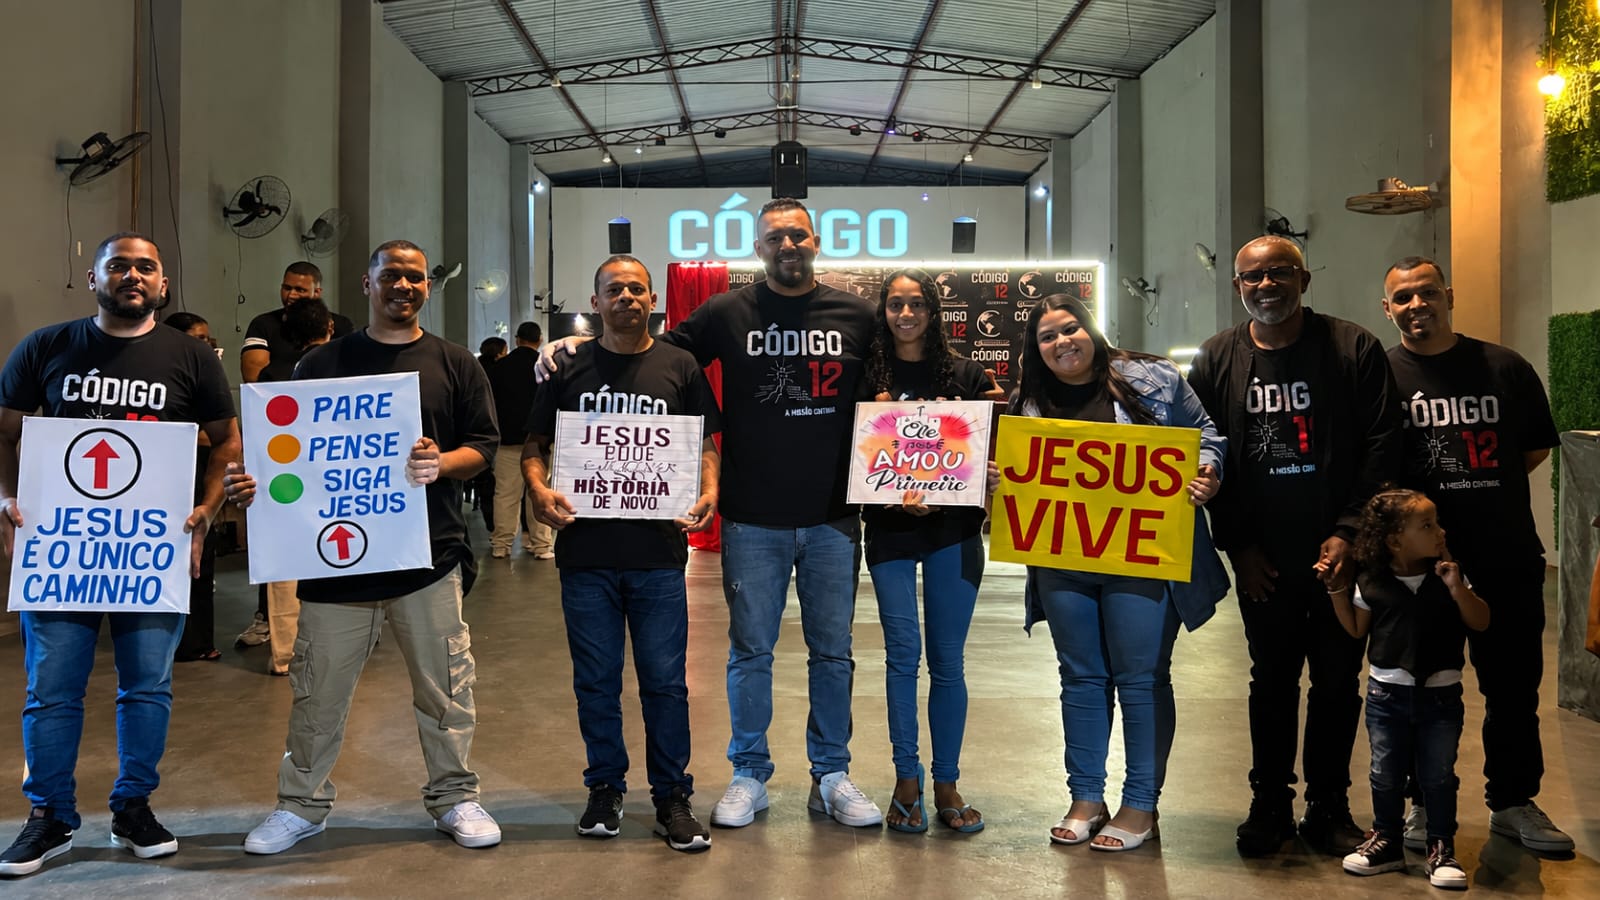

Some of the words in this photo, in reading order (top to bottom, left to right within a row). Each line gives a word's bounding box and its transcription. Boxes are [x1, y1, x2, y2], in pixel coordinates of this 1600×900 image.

[668, 192, 908, 258] CÓGO
[971, 269, 1009, 284] CÓDIGO
[1055, 268, 1093, 283] CÓDIGO
[1078, 283, 1092, 298] 12
[994, 284, 1009, 299] 12
[942, 311, 967, 322] DIGO
[952, 323, 967, 337] 12
[746, 322, 842, 357] CÓDIGO
[971, 347, 1009, 361] CÓDIGO
[808, 361, 843, 399] 12
[996, 362, 1009, 376] 12
[62, 368, 167, 410] CÓDIGO
[579, 384, 668, 415] CÓDIGO
[1246, 376, 1311, 413] ÓDIG
[313, 392, 393, 423] PARE
[308, 432, 400, 462] PENSE
[581, 425, 671, 447] JESUS
[1293, 415, 1314, 454] 1
[1462, 430, 1498, 469] 12
[873, 448, 965, 472] AMOU
[1004, 436, 1185, 497] JESUS
[323, 465, 391, 493] SIGA
[318, 491, 406, 518] JESUS
[592, 495, 611, 509] DE
[36, 507, 167, 537] JESUS
[1003, 494, 1165, 565] VIVE
[21, 536, 38, 569] É
[47, 540, 69, 569] O
[78, 533, 174, 570] ÚNICO
[22, 574, 162, 604] CAMINHO
